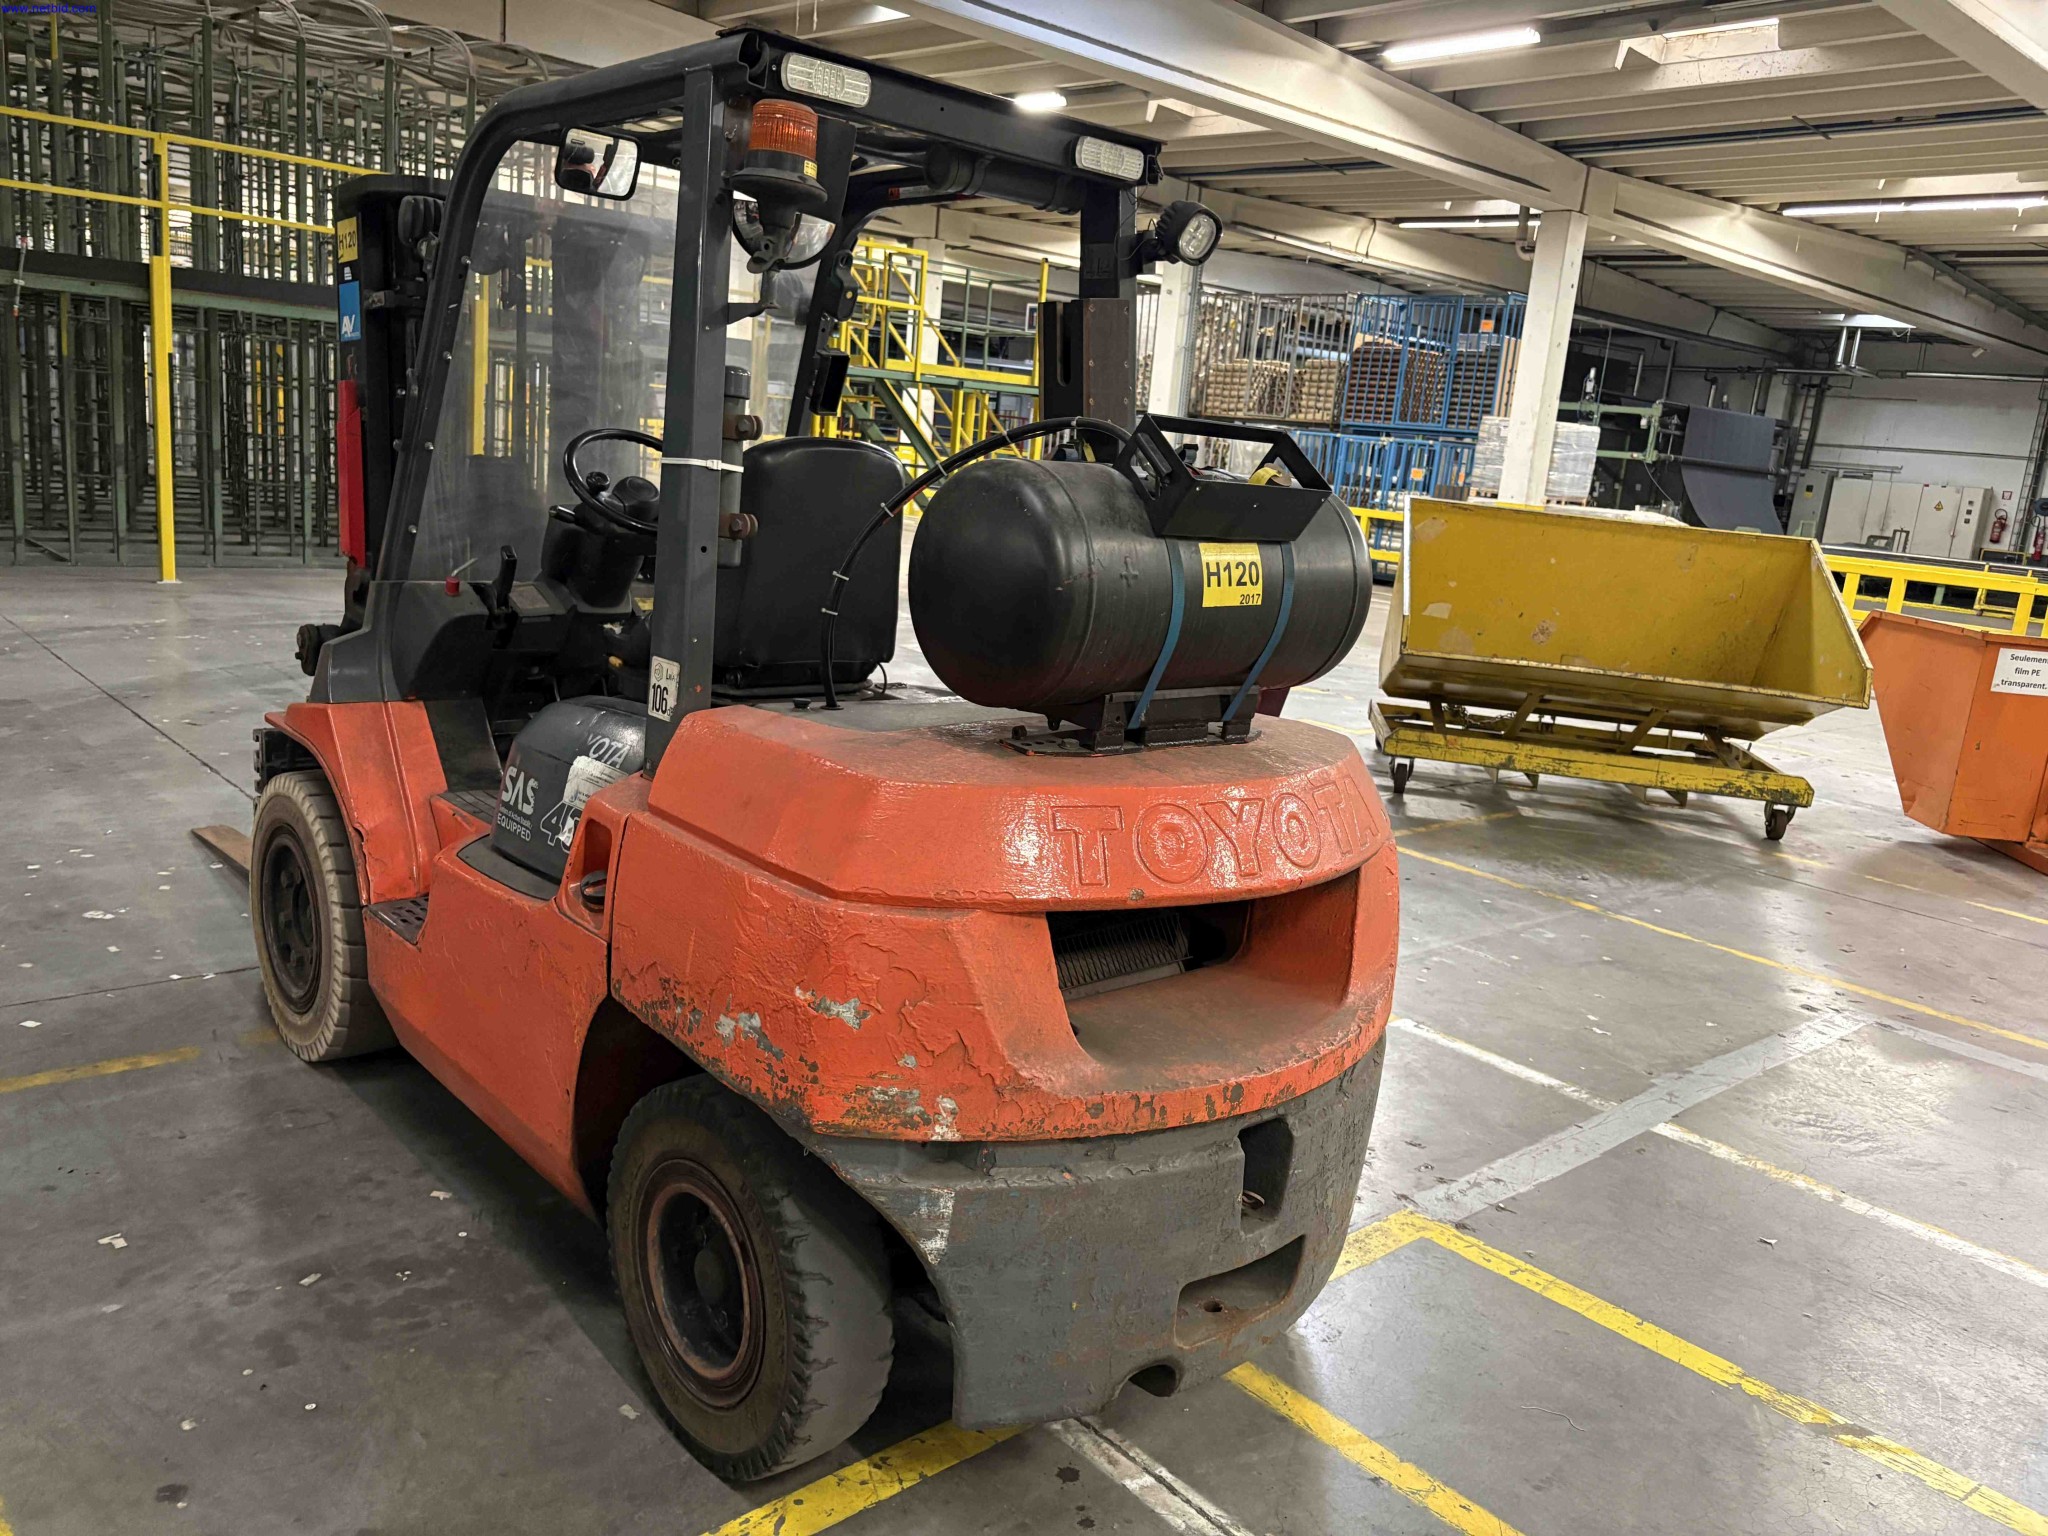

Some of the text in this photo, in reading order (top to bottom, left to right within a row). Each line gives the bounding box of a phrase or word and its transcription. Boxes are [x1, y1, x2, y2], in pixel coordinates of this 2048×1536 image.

[339, 231, 357, 250] H120
[1206, 561, 1260, 588] H120
[1240, 593, 1261, 605] 2017
[2001, 679, 2047, 690] transparent.
[2014, 667, 2041, 677] film PE
[651, 683, 669, 715] 106
[501, 766, 539, 815] SAS
[497, 813, 531, 841] EQUIPPED
[1050, 774, 1380, 888] TOYOTA
